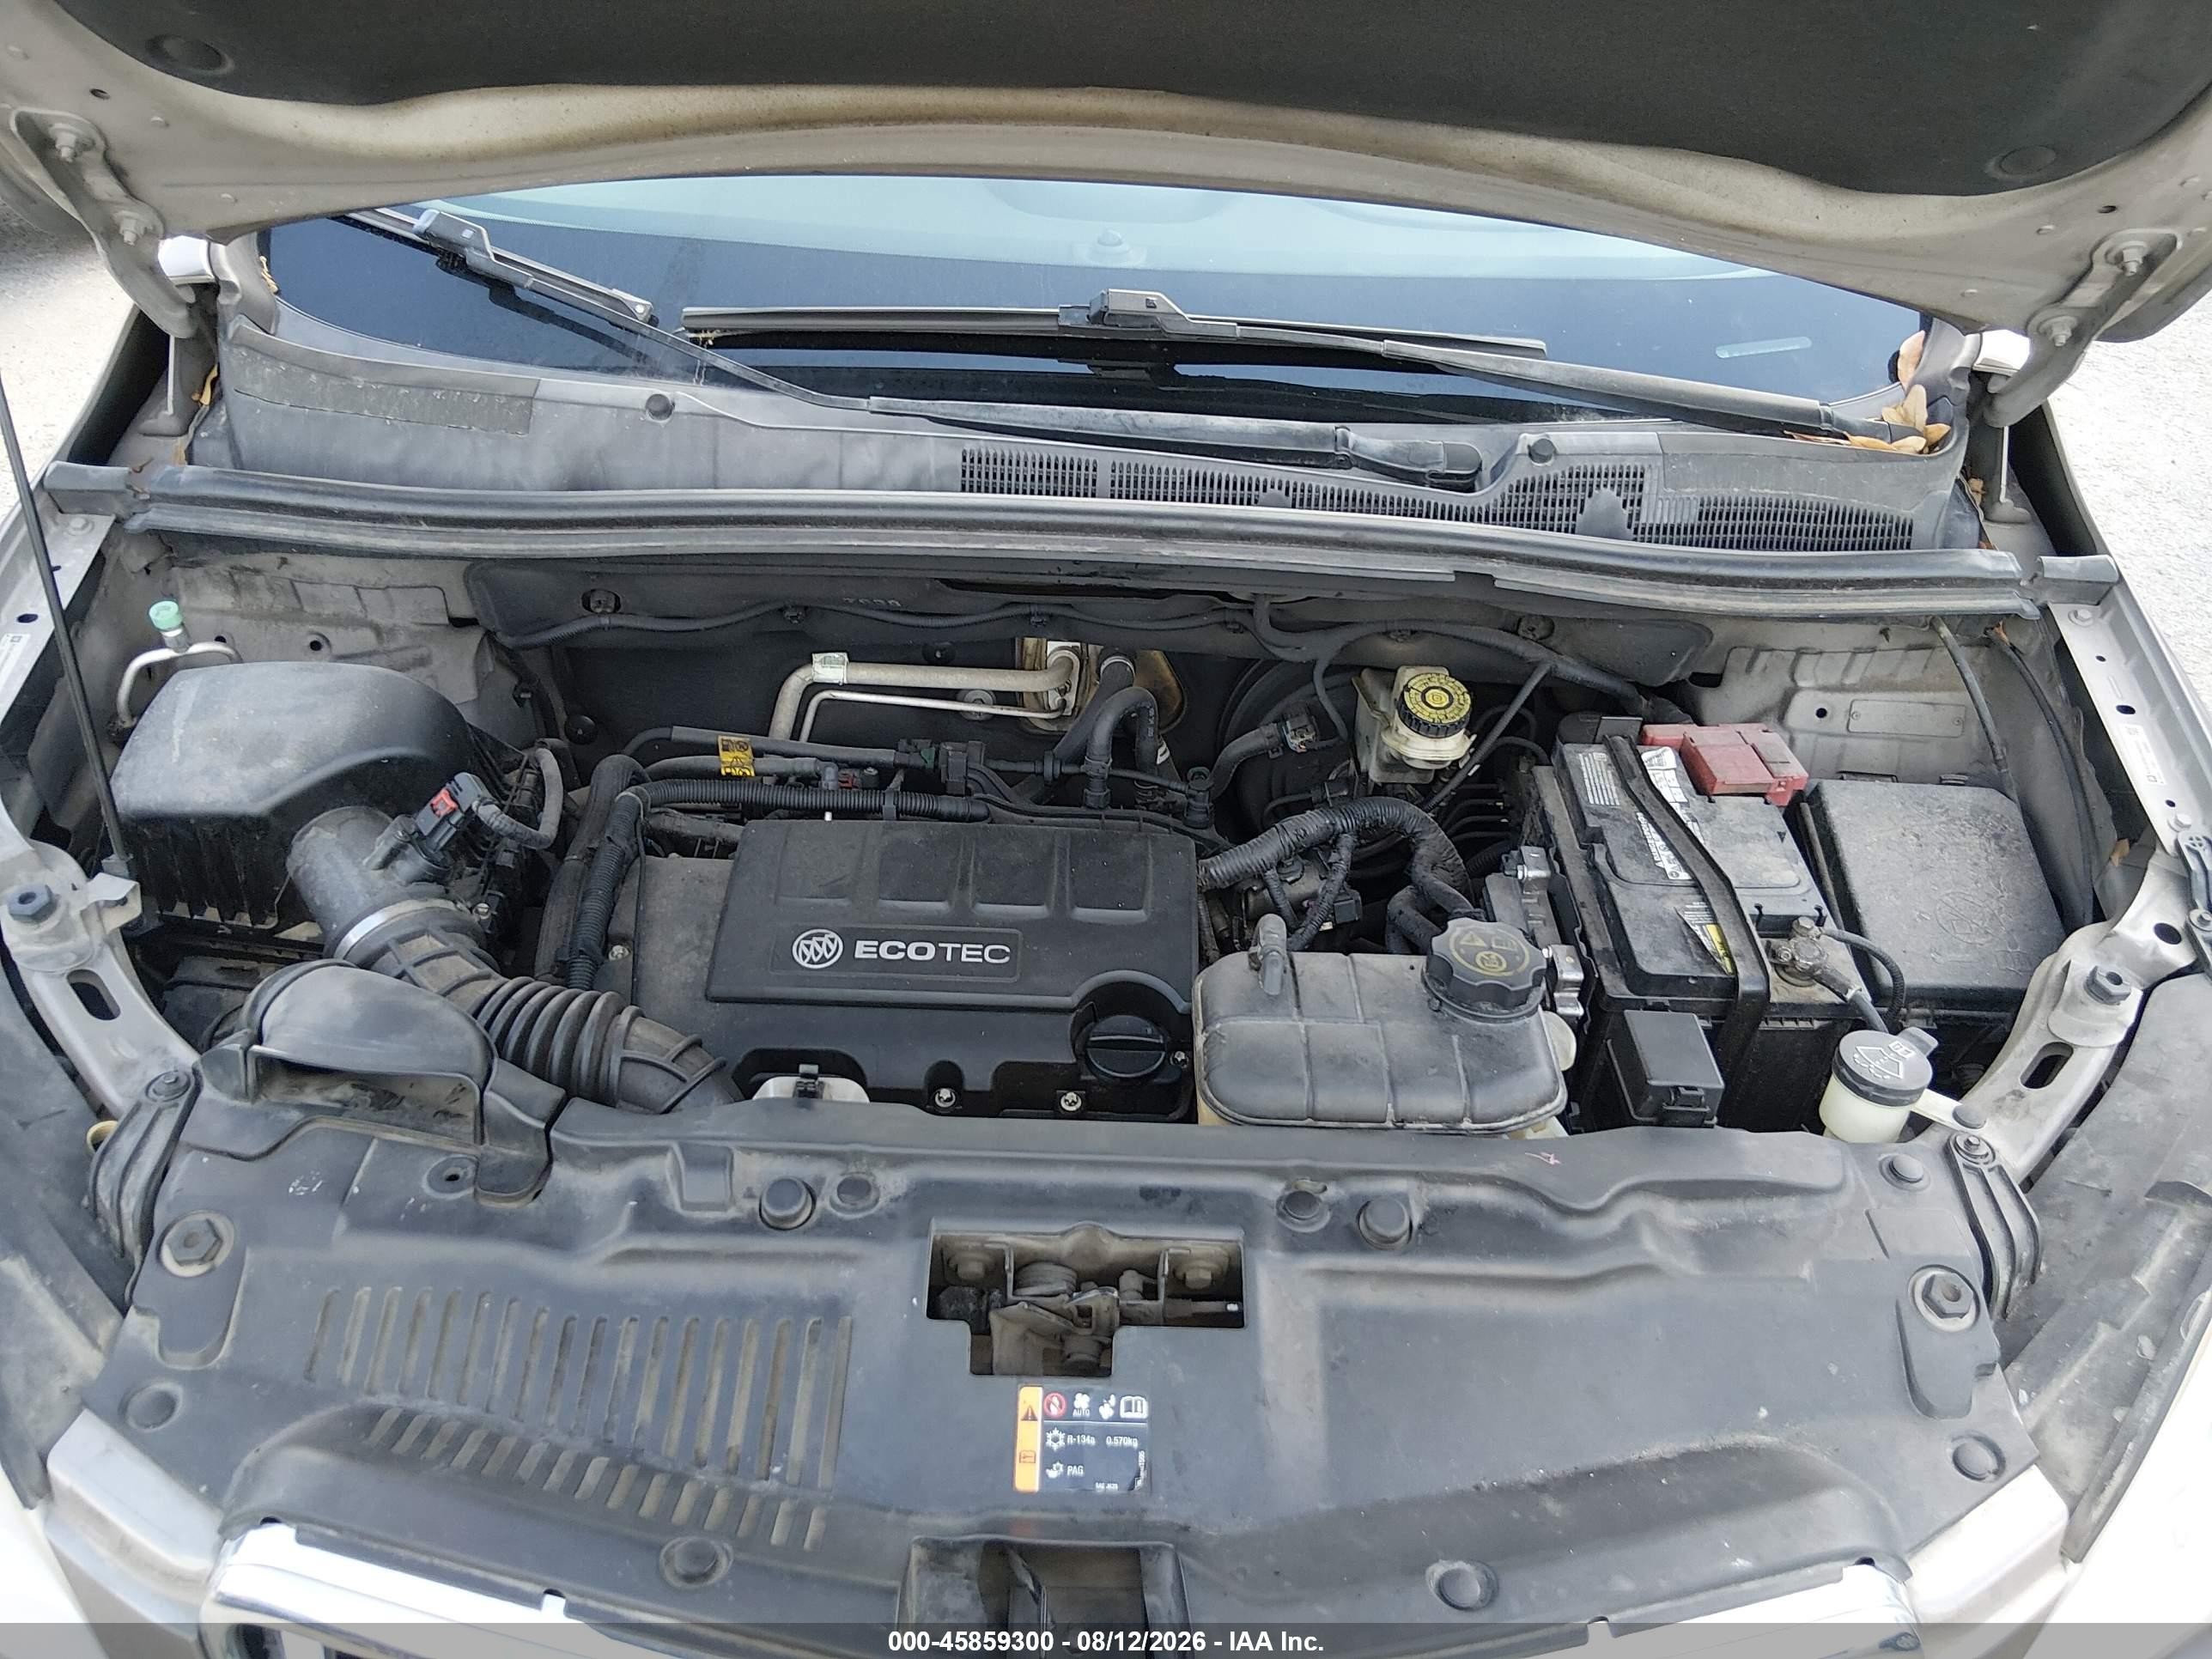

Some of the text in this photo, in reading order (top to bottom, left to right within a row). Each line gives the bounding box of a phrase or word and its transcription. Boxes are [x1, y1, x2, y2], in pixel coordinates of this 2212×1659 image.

[854, 939, 1011, 963] ECOTEC
[1067, 1435, 1138, 1449] R-134a 0.570kg
[1067, 1465, 1084, 1476] PAG
